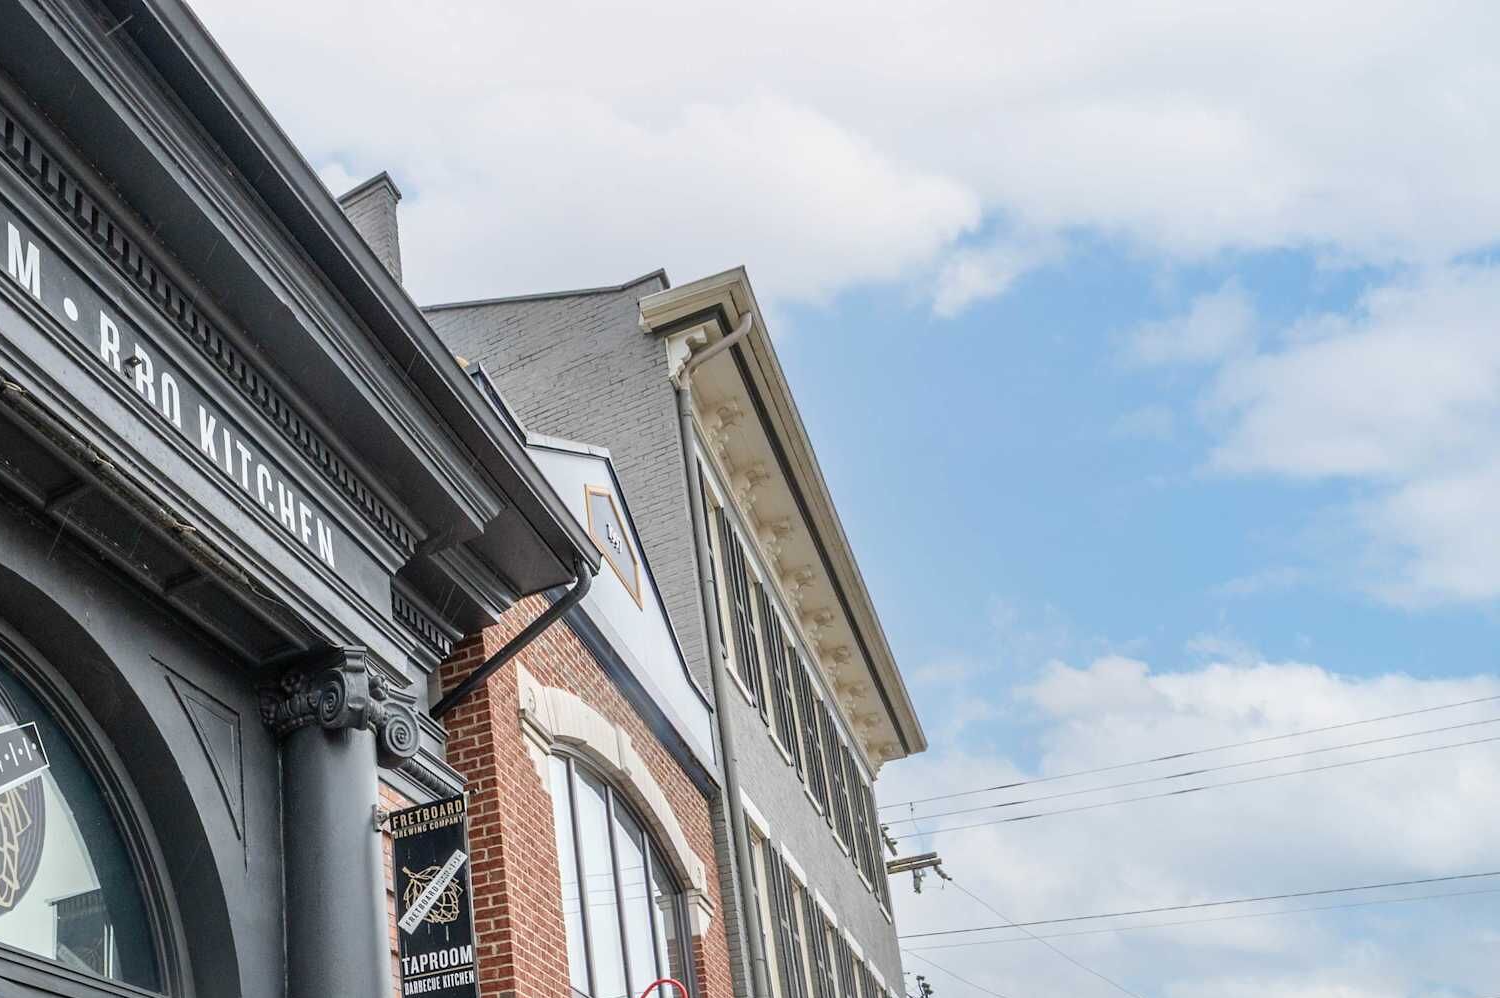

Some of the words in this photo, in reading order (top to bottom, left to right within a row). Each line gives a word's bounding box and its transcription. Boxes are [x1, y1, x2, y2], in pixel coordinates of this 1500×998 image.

[200, 405, 335, 568] KITCHEN
[393, 799, 463, 829] FRETBOARD
[394, 823, 427, 840] BREWING
[429, 814, 464, 831] COMPANY
[405, 884, 439, 927] FRETBOARD
[402, 944, 473, 976] TAPROOM
[404, 976, 441, 996] BARBECUE
[443, 969, 475, 989] KITCHEN
